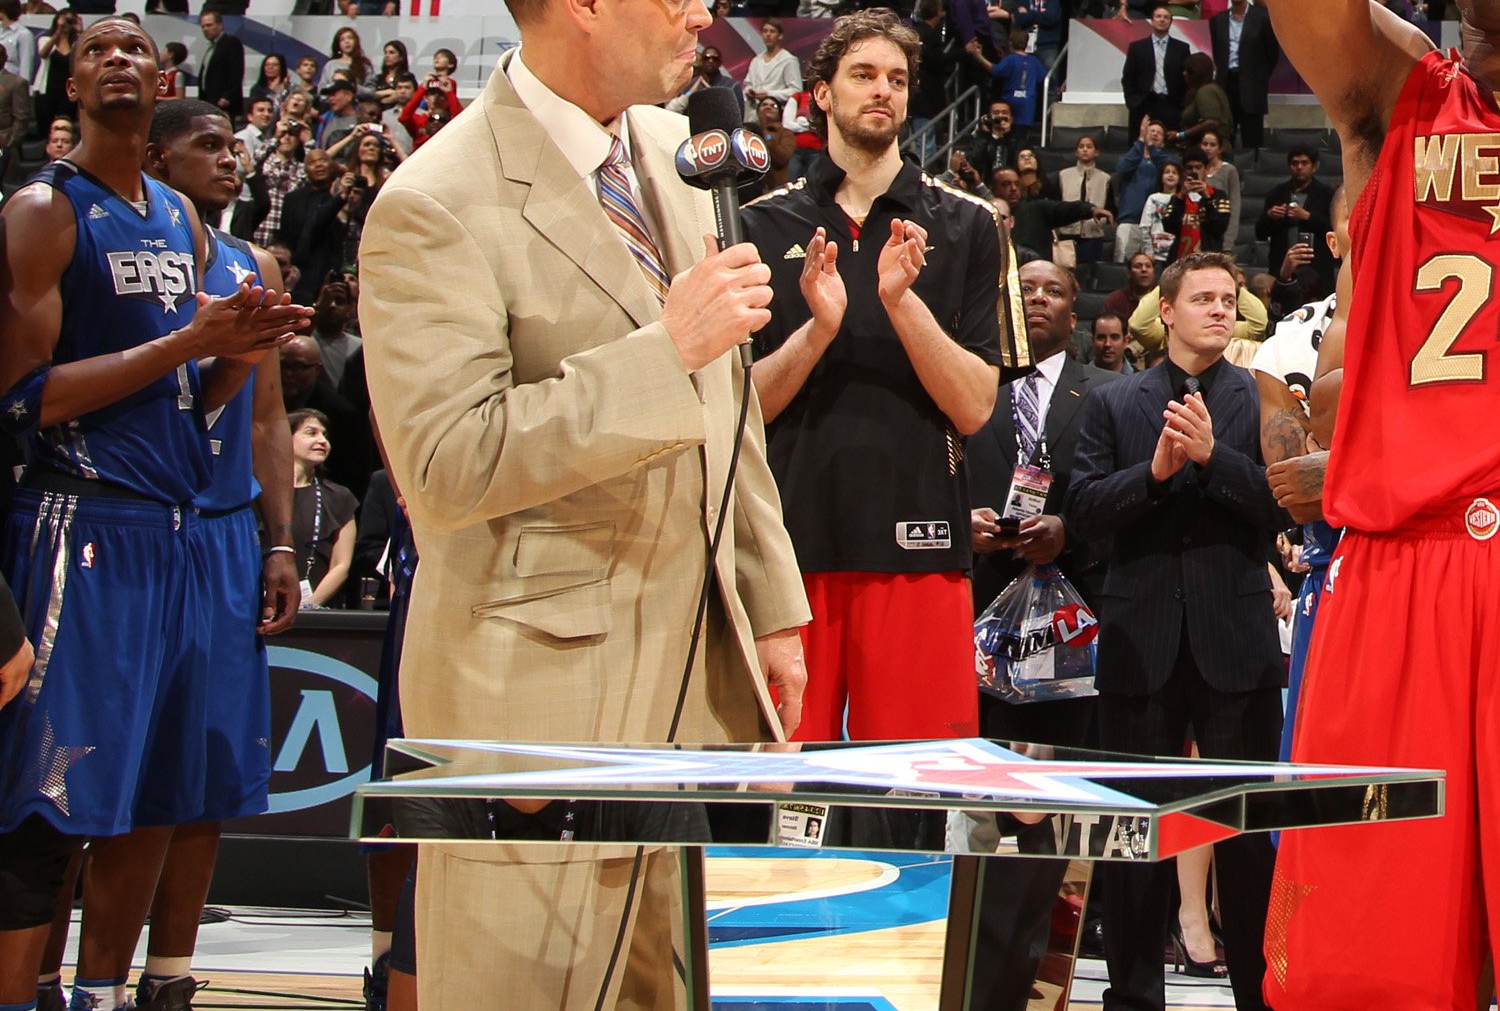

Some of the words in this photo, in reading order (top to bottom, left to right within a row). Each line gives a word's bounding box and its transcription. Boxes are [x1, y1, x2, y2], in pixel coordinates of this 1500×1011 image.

[702, 142, 724, 157] TNT
[750, 147, 766, 160] TNT
[141, 239, 168, 248] THE
[107, 250, 196, 295] EAST
[1057, 608, 1098, 643] LA
